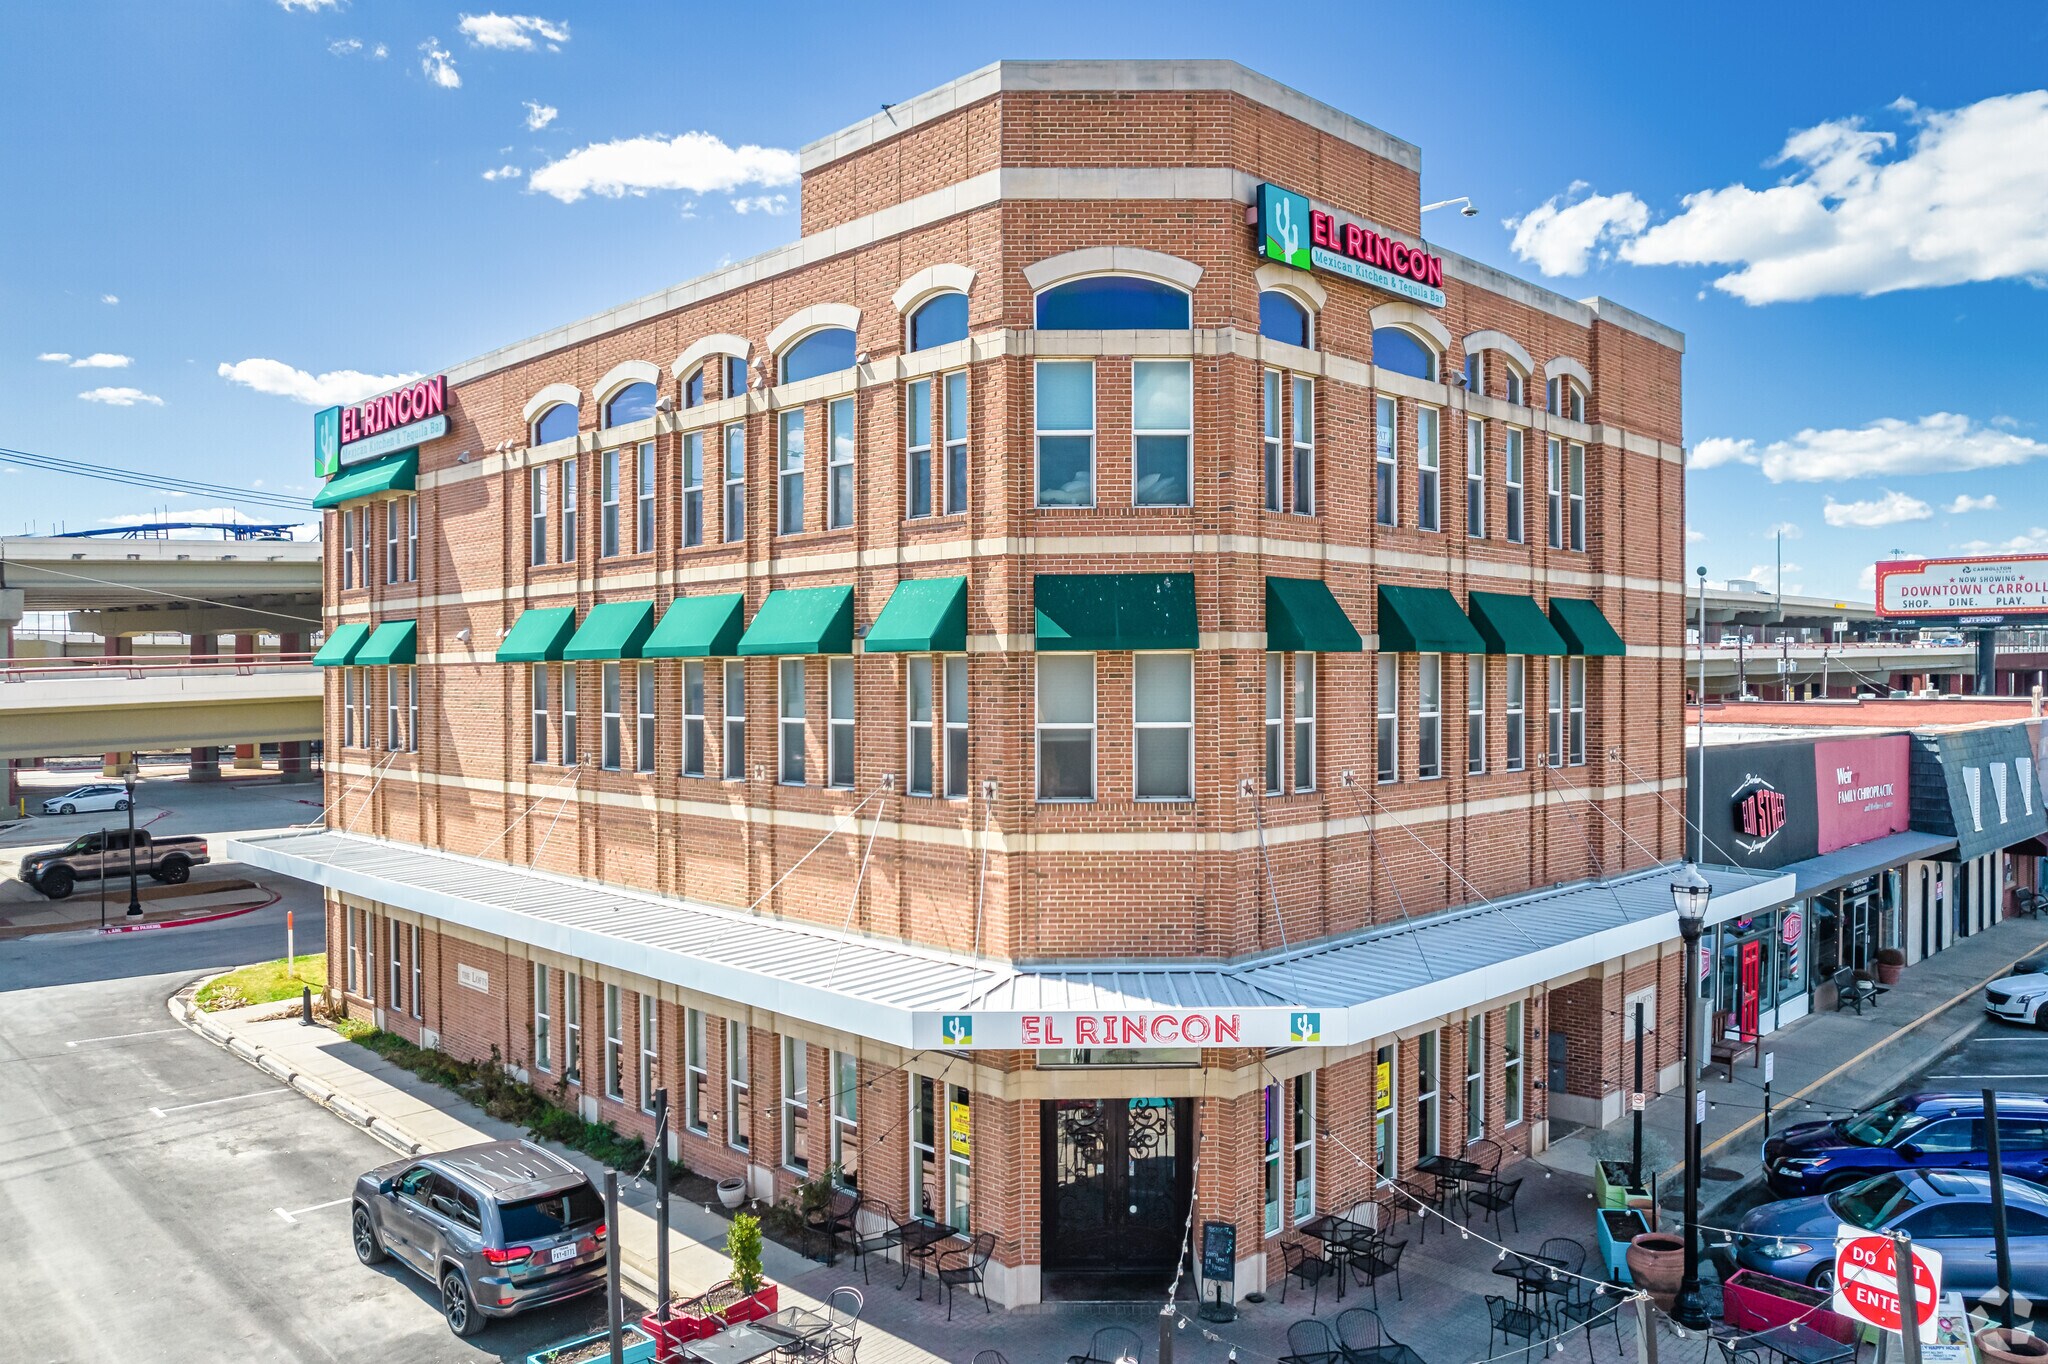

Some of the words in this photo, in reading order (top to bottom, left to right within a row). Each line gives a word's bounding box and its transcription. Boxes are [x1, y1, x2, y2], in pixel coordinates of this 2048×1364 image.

[1311, 209, 1341, 251] EL
[1344, 222, 1443, 288] RINCON
[1314, 249, 1353, 274] Mexican
[1355, 264, 1389, 286] Kitchen
[1391, 276, 1397, 288] &
[1398, 279, 1429, 299] Tequila
[1430, 290, 1443, 304] Bar
[341, 406, 361, 444] EL
[364, 374, 448, 436] RINCON
[430, 420, 443, 435] Bar
[1901, 584, 1982, 597] DOWNTOWN
[1988, 581, 2048, 595] CARROLL
[1979, 575, 2016, 583] SHOWING
[1902, 599, 1932, 609] SHOP.
[1949, 597, 1978, 607] DINE.
[1996, 596, 2025, 606] PLAY.
[1838, 789, 1857, 804] FAMILY
[1857, 783, 1894, 801] CHIROPRACTIC
[1022, 1016, 1063, 1045] EL
[1076, 1014, 1240, 1045] RINCON
[1852, 1246, 1877, 1265] DO
[1887, 1256, 1924, 1280] NT
[1856, 1287, 1901, 1314] ENTE
